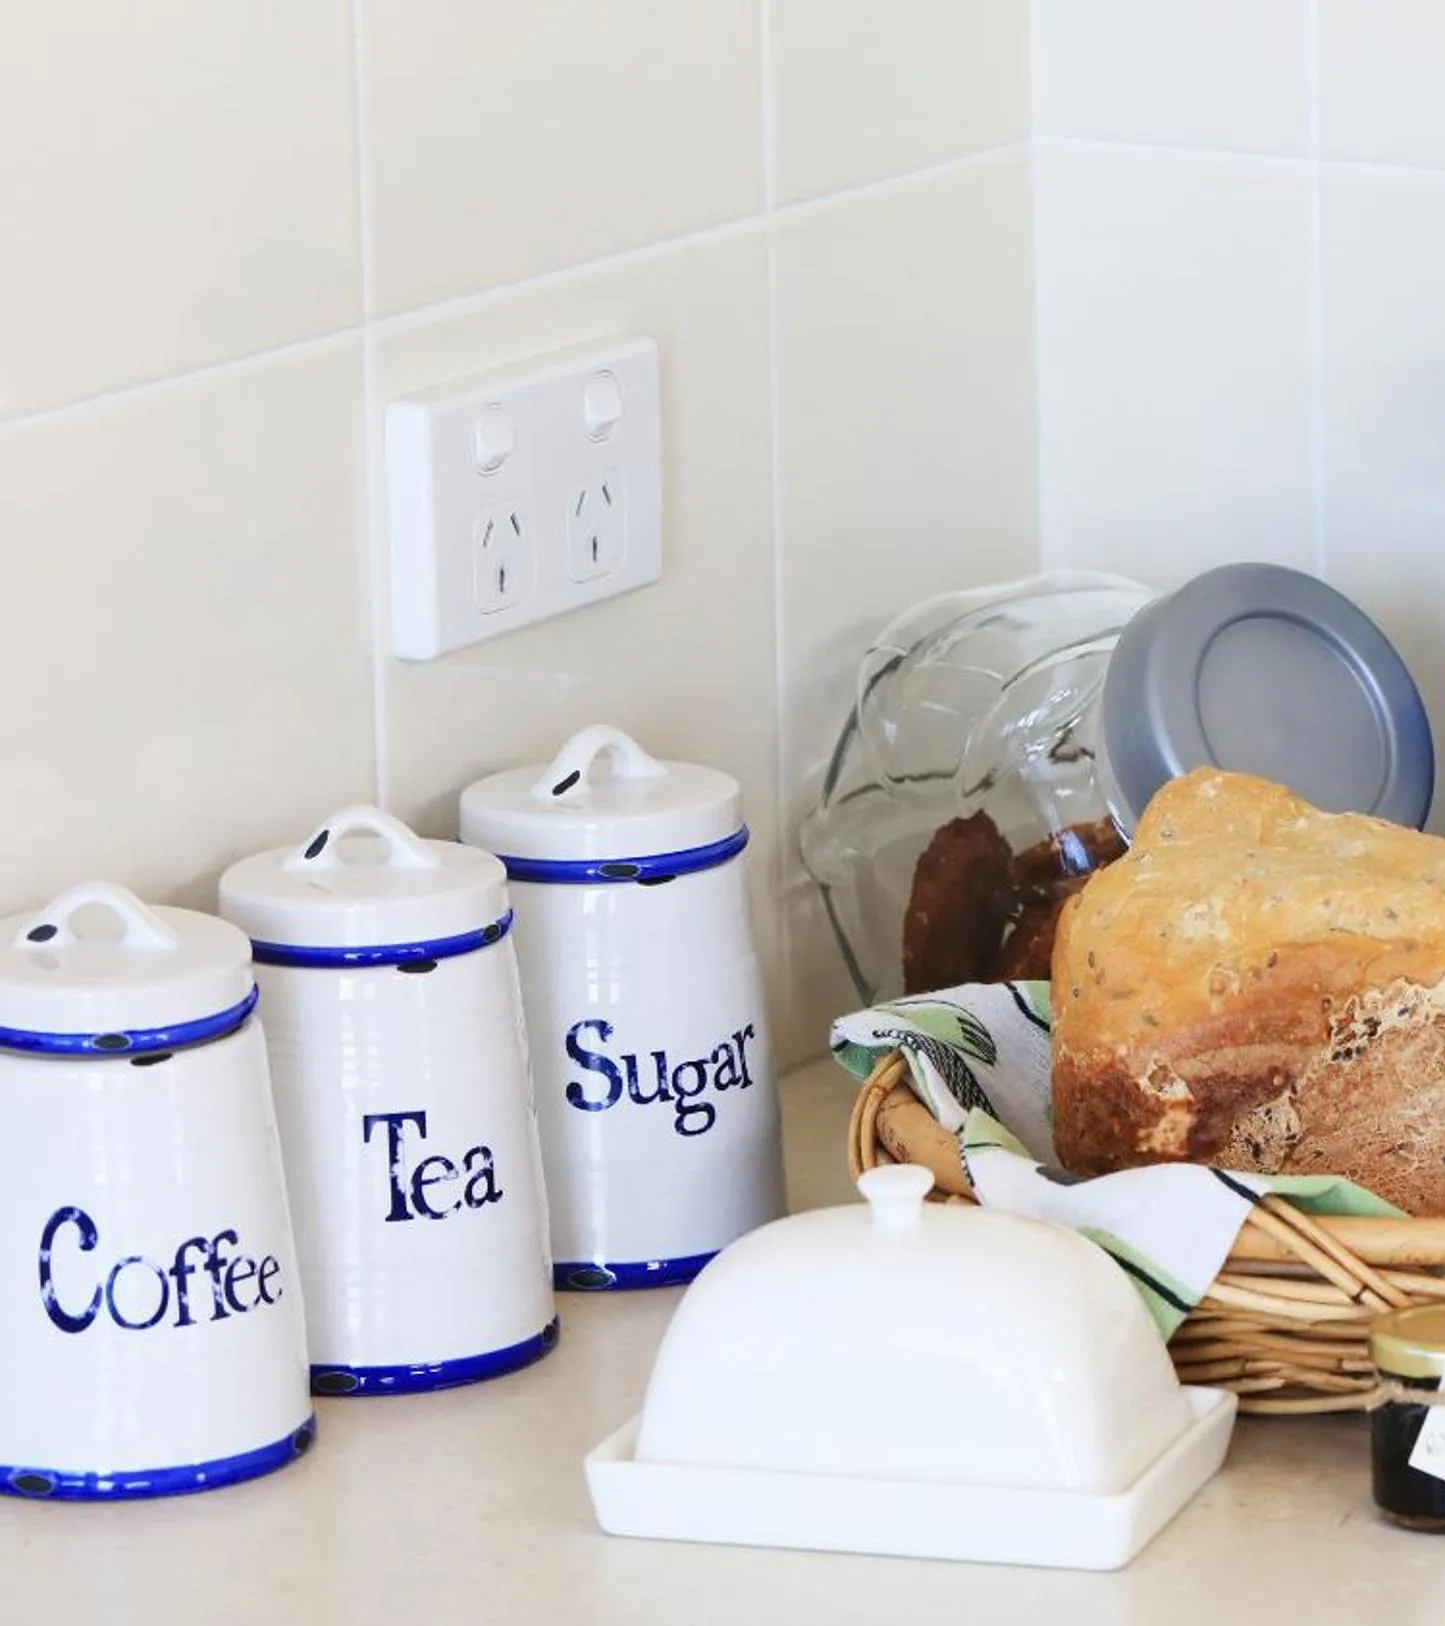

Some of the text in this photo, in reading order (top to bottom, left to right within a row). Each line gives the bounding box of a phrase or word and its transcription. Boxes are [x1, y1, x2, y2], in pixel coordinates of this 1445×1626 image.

[564, 1018, 756, 1137] Sugar
[363, 1110, 504, 1222] Tea
[38, 1206, 284, 1334] Coffee
